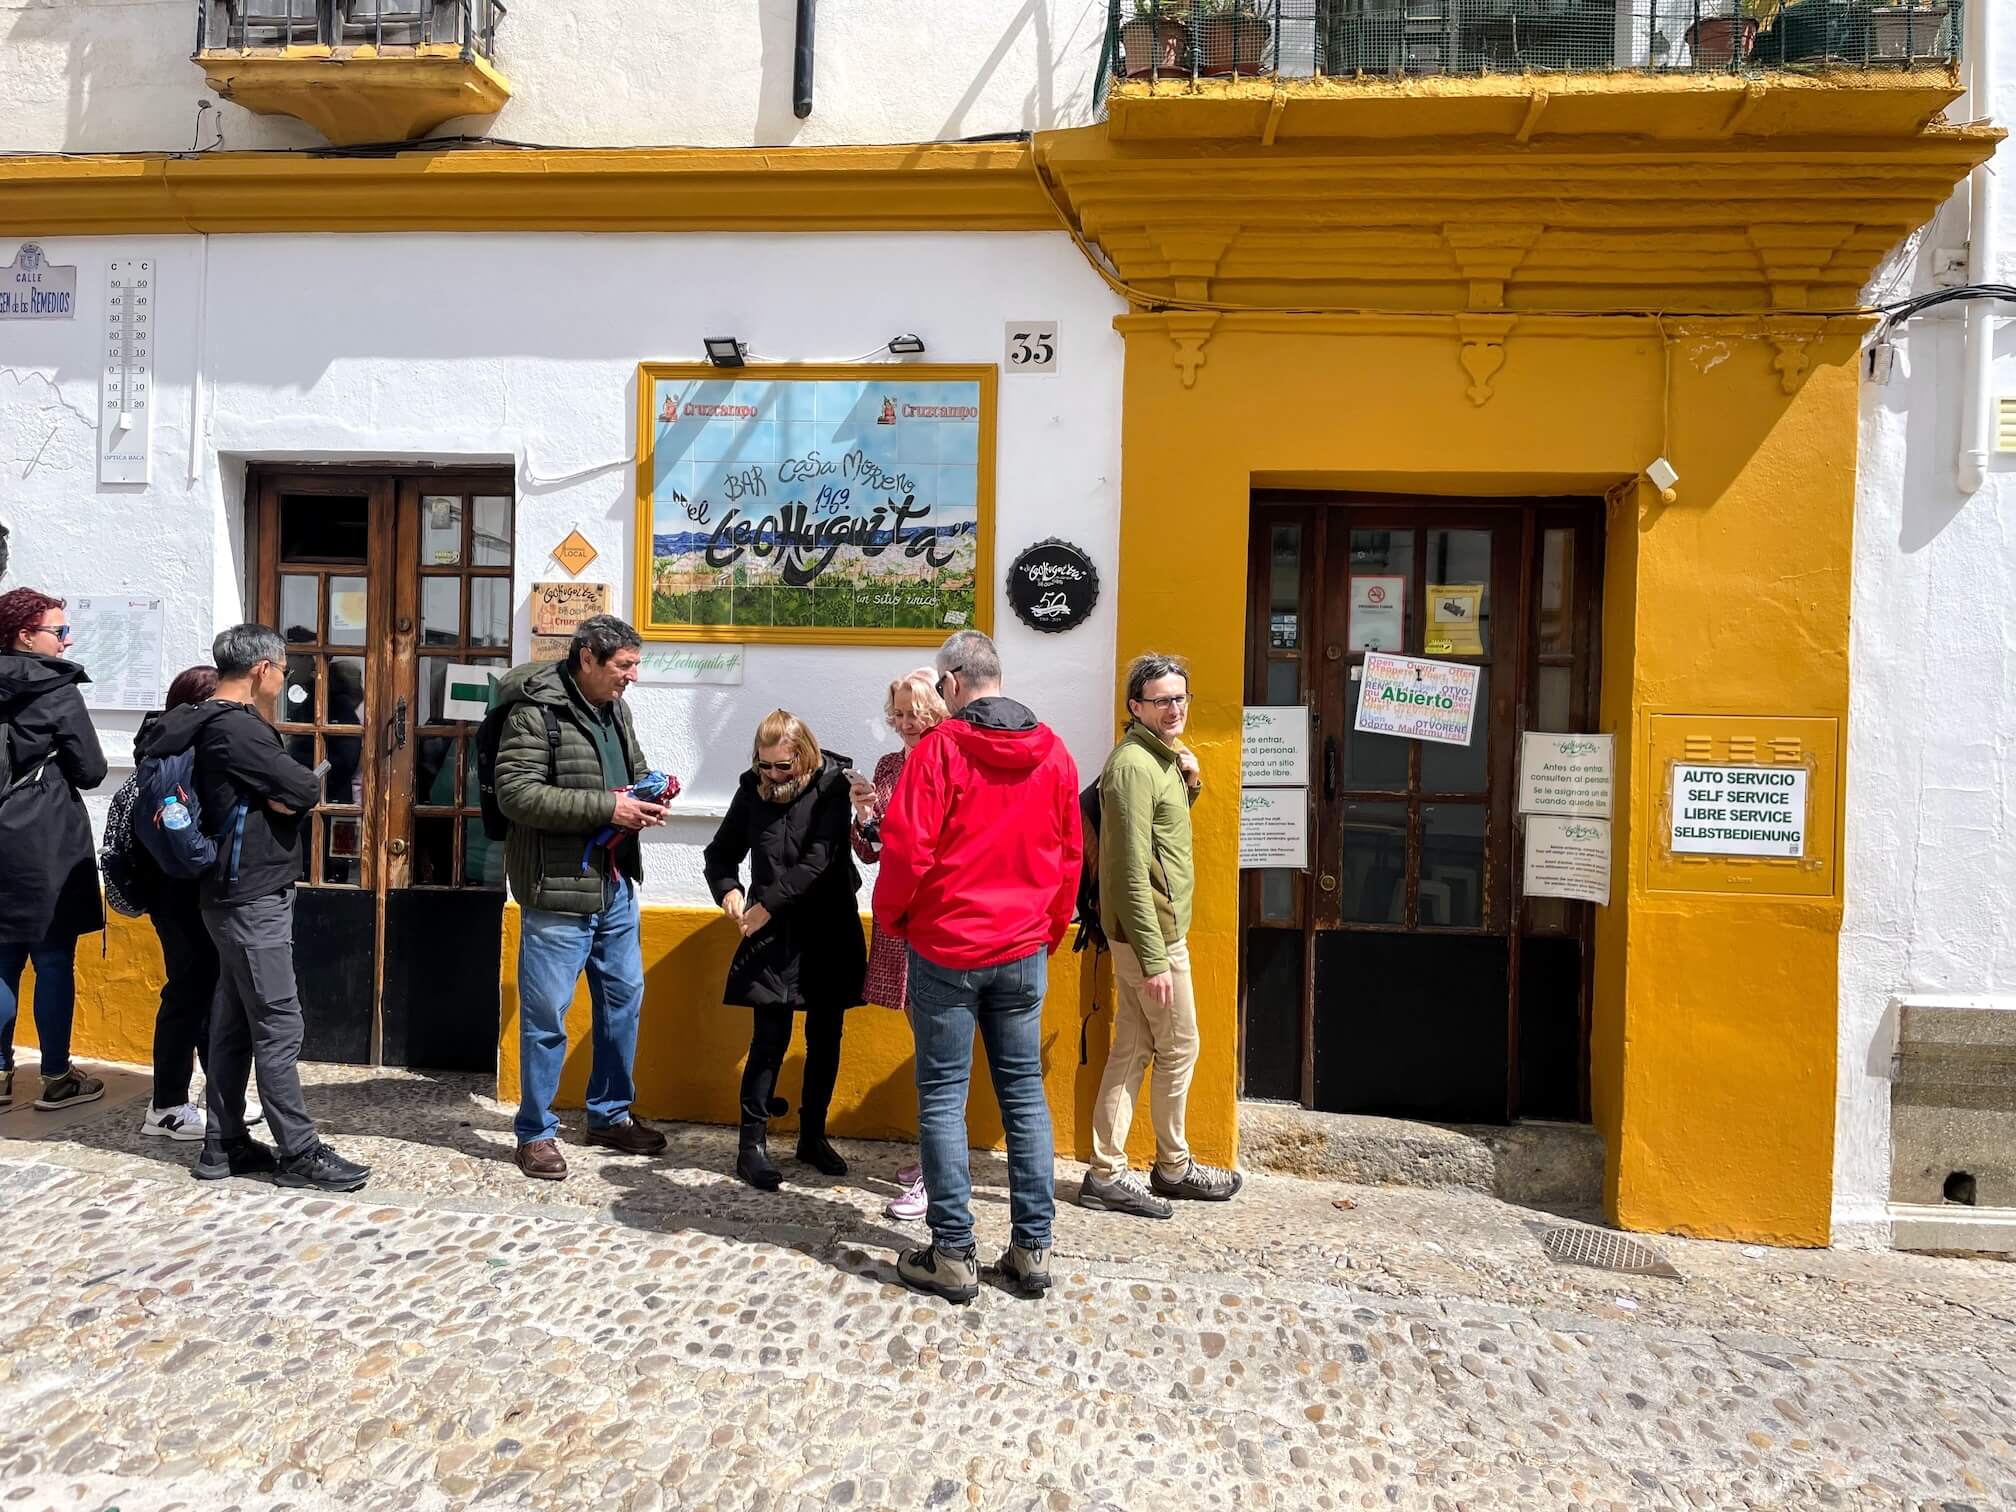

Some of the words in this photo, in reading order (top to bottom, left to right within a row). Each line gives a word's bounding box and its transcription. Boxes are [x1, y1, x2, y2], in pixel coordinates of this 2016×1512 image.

[141, 262, 148, 270] C
[16, 273, 42, 282] CALLE
[111, 280, 121, 288] 50
[137, 280, 147, 288] 50
[30, 286, 70, 313] REMEDIOS
[109, 331, 120, 339] 20
[136, 331, 146, 339] 20
[1011, 333, 1053, 365] 35
[107, 400, 118, 408] 20
[134, 400, 145, 408] 20
[683, 402, 758, 419] Cruzcampo
[902, 404, 978, 420] Cruzcampo
[724, 465, 767, 501] BAR
[1381, 686, 1453, 710] Abierto
[1246, 736, 1257, 744] de
[1250, 746, 1258, 754] al
[1278, 759, 1295, 767] sitio
[1543, 763, 1567, 772] Antes
[1247, 769, 1271, 778] quede
[1530, 773, 1572, 783] consulten
[1574, 775, 1583, 783] al
[1683, 770, 1723, 784] AUTO
[1727, 772, 1795, 786] SERVICIO
[1533, 786, 1543, 794] Se
[1544, 786, 1552, 794] le
[1535, 797, 1567, 805] cuando
[1688, 789, 1724, 802] SELF
[1727, 790, 1790, 805] SERVICE
[1684, 807, 1727, 821] LIBRE
[1729, 809, 1793, 823] SERVICE
[1674, 826, 1801, 842] SELBSTBEDIENUNG
